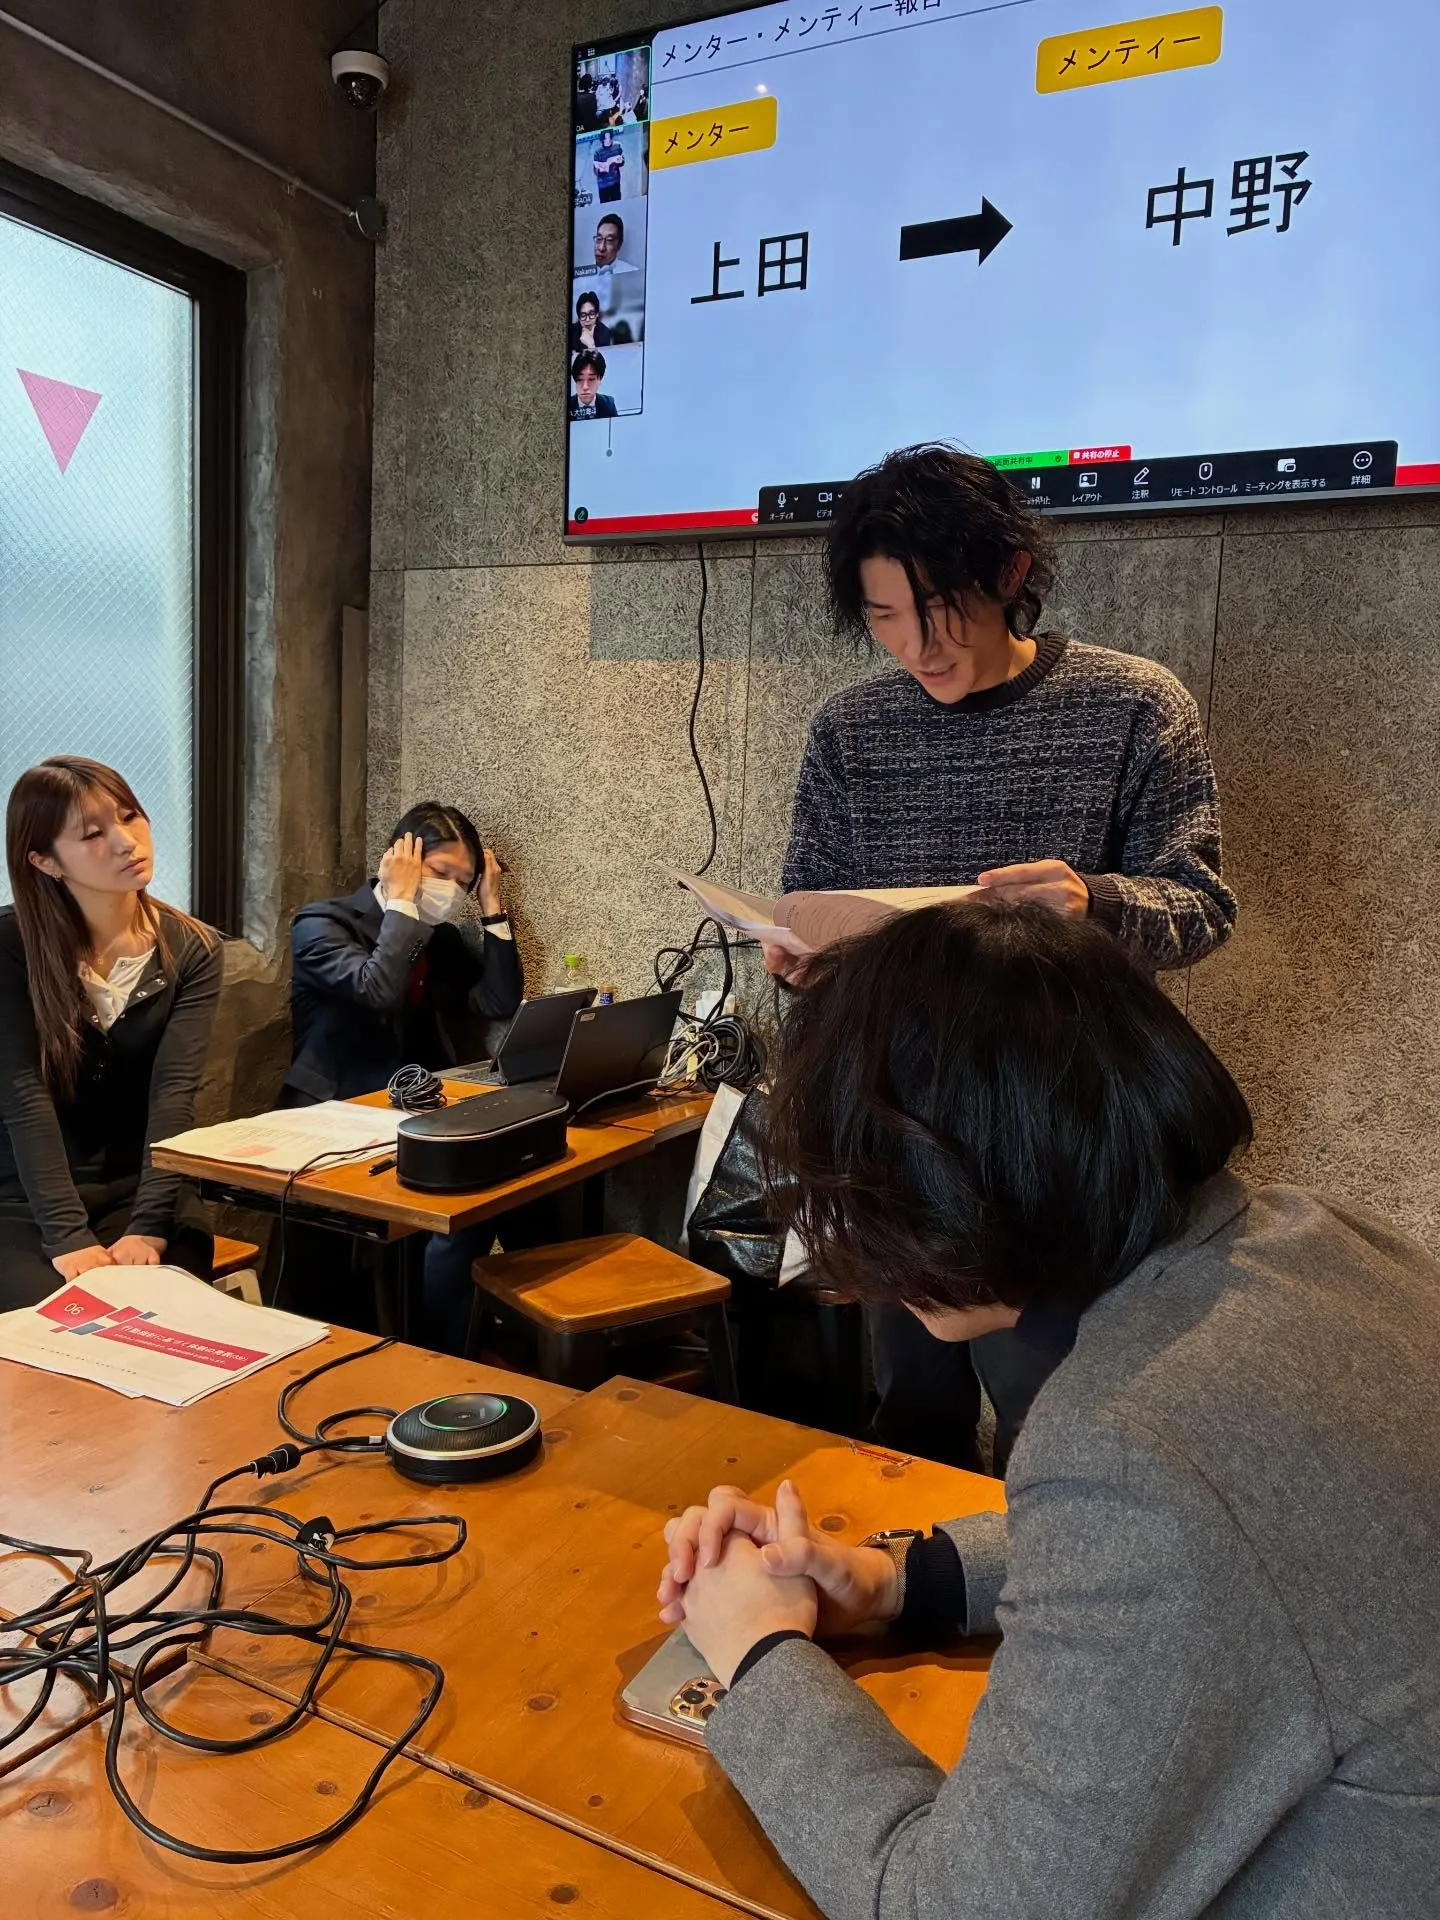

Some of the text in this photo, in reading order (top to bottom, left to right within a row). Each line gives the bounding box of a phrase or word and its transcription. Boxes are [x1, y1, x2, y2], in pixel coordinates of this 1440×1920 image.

[1057, 35, 1201, 75] メンティー
[663, 122, 750, 154] メンター
[1145, 150, 1313, 247] 中野
[690, 231, 809, 305] 上田
[1081, 450, 1120, 460] 共有の停止
[1245, 478, 1327, 492] ミーティングを表示する
[1351, 475, 1371, 485] 詳細
[1131, 489, 1150, 499] 注釈
[1171, 484, 1239, 497] リモート コントロール
[1072, 493, 1103, 502] レイアウト
[816, 509, 833, 518] ビデオ
[64, 1302, 85, 1315] 06
